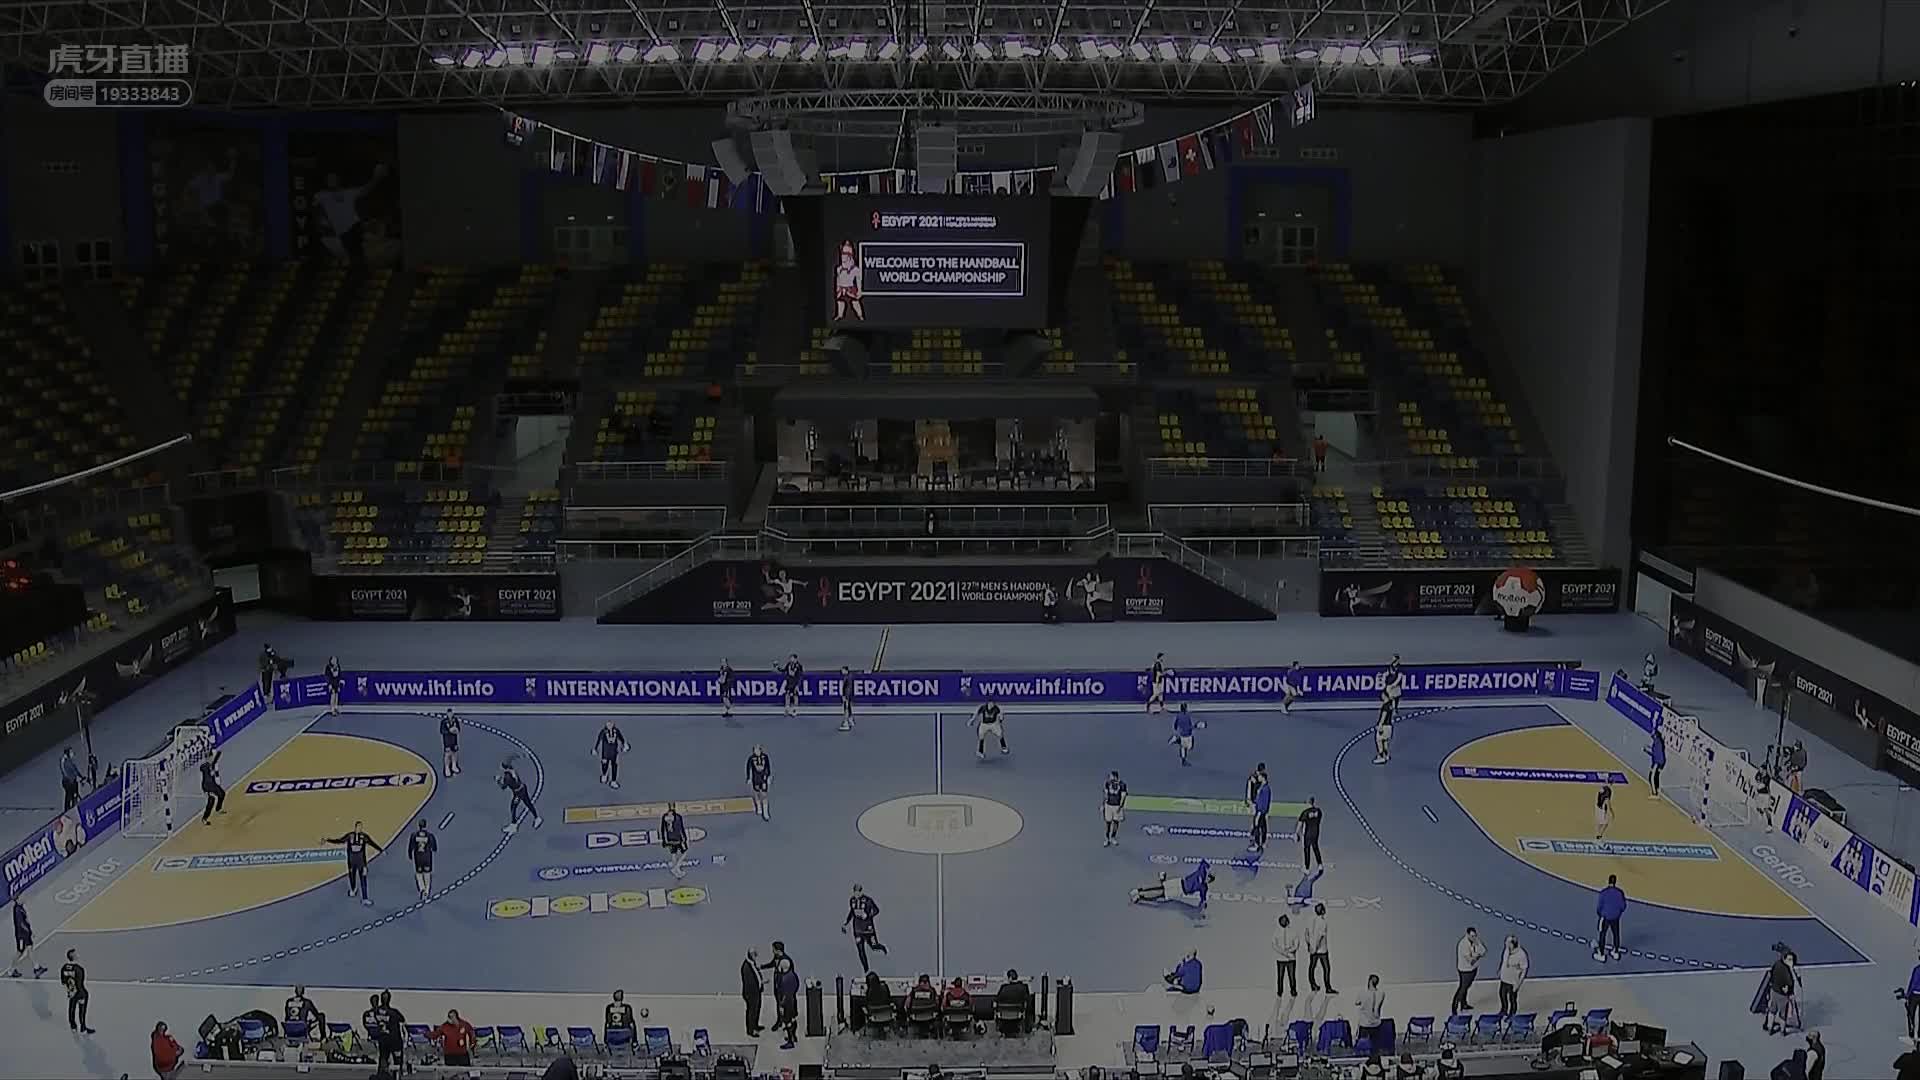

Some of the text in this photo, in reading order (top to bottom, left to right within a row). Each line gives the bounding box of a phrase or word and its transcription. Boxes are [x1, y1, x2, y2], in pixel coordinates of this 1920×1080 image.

[881, 215, 943, 227] EGYPT 2021
[864, 257, 1019, 269] WELCOME TO THE HANDBALL
[879, 271, 1007, 283] WORLD CHAMPIONSHIP
[351, 589, 408, 600] EGYPT 2021
[498, 589, 556, 600] EGYPT 2021
[838, 581, 954, 601] EGYPT 2021
[961, 591, 1043, 601] WORLD CHAMPION
[1419, 584, 1475, 595] EGYPT 2021
[1562, 583, 1616, 594] EGYPT 2021
[374, 679, 495, 697] www.ihf.info
[546, 680, 701, 697] INTERNATIONAL
[706, 680, 812, 697] HNDBAL
[979, 677, 1105, 696] www.ihf.info
[1162, 671, 1537, 694] NTERNATIONL HANDBLL FEDERATION
[1796, 676, 1833, 705] EGYPT 2021
[6, 703, 44, 734] EGYPT 2021
[1887, 724, 1912, 747] EGYPT
[4, 832, 51, 882] molten
[294, 848, 346, 862] Meetin
[1751, 844, 1815, 889] Gerflor
[54, 857, 121, 904] Gerflor
